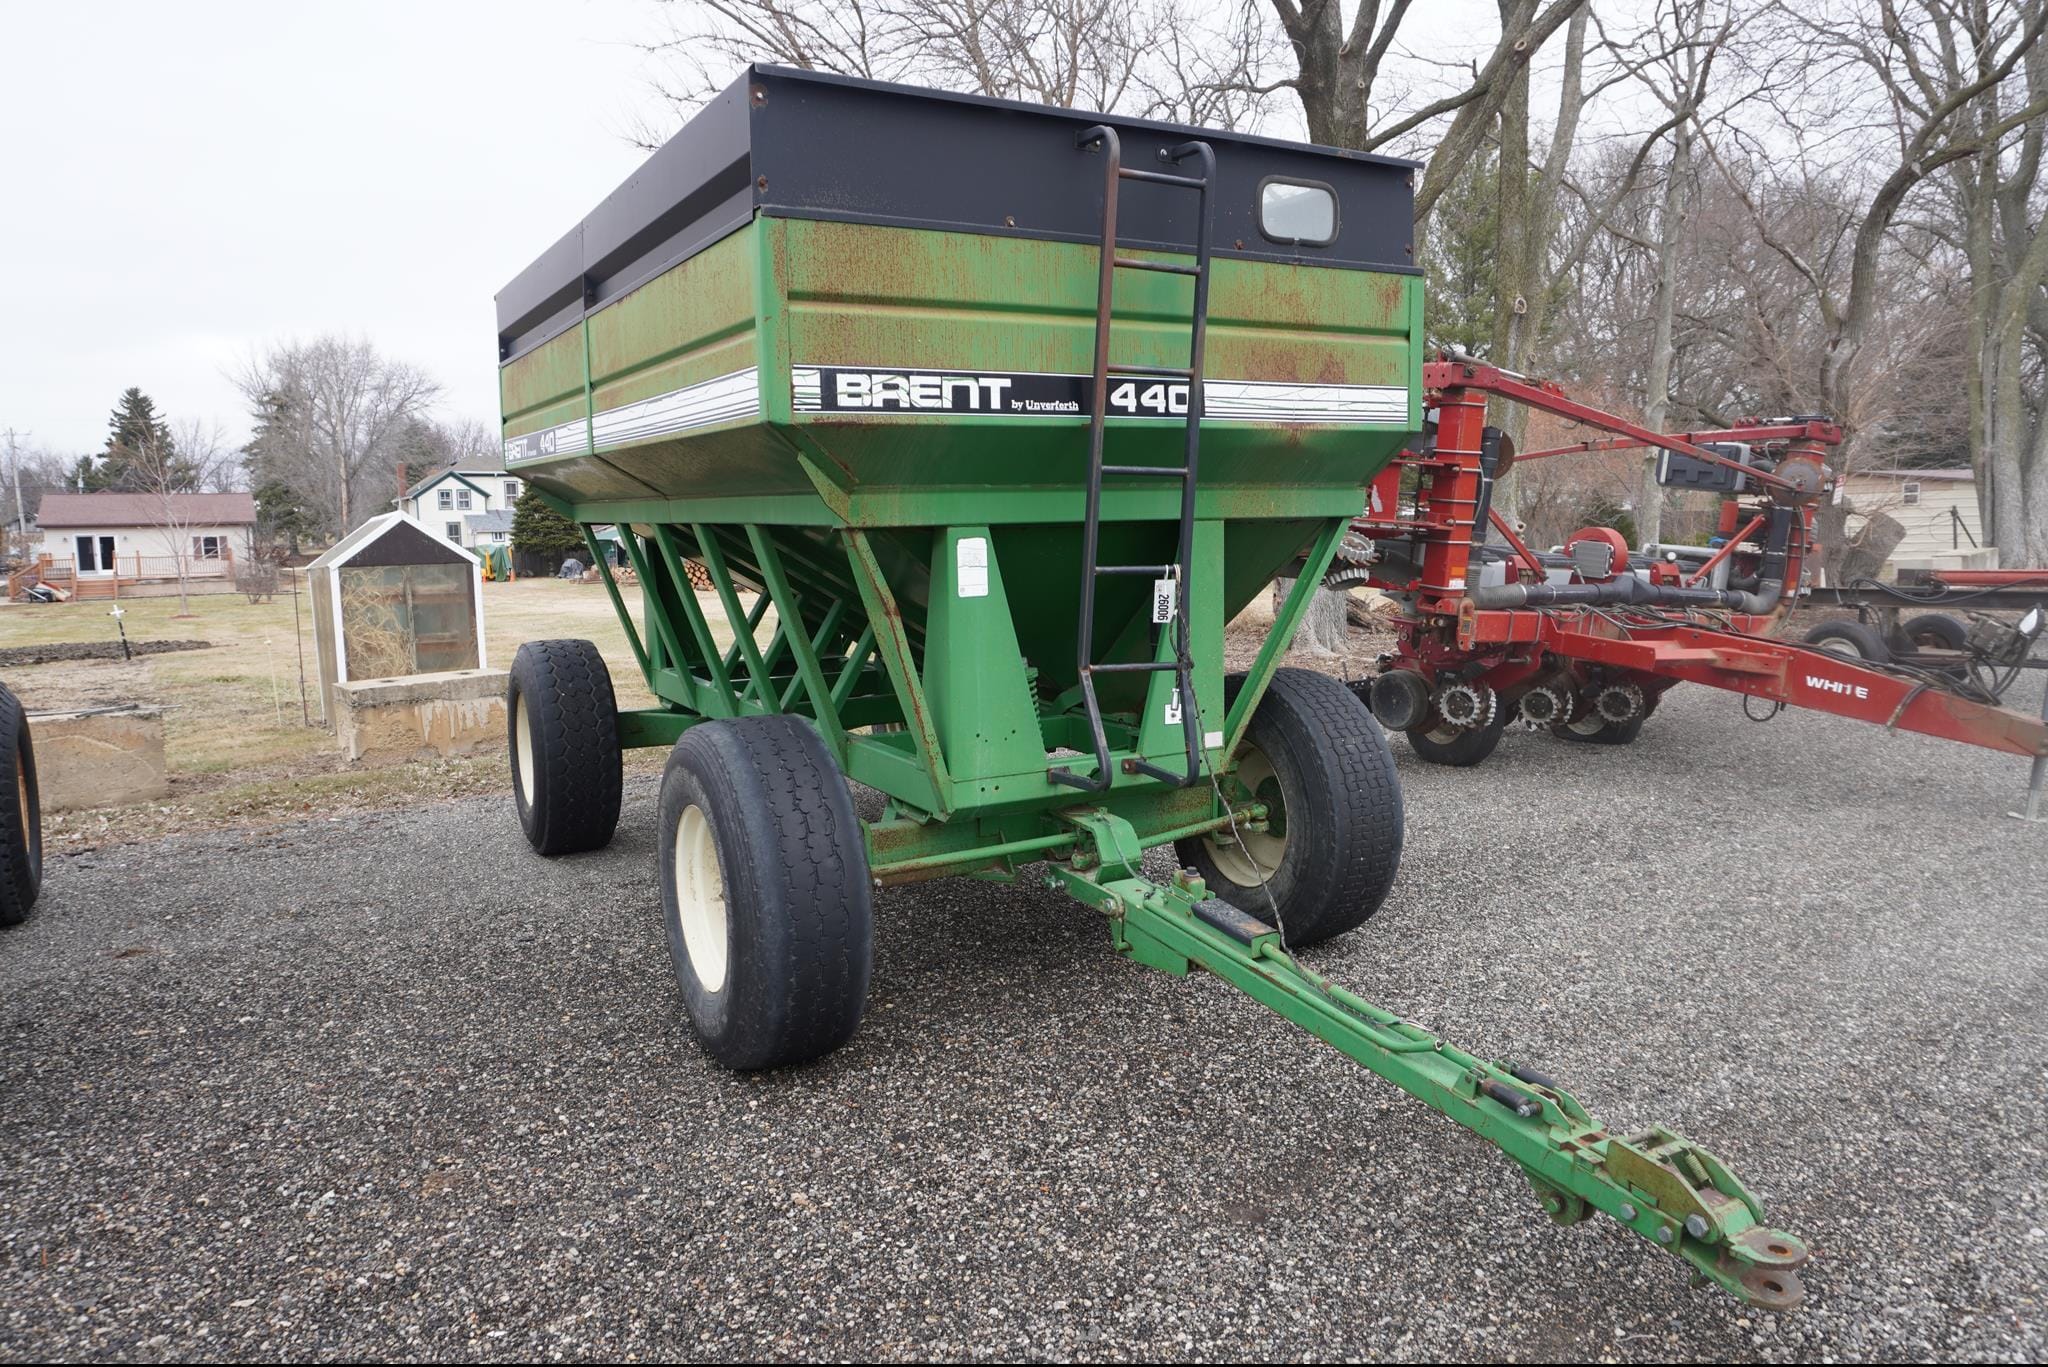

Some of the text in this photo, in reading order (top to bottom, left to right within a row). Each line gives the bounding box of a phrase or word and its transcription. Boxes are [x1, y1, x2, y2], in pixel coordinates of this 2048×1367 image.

[836, 373, 1190, 414] BRENT by Unverferth 440
[1157, 594, 1170, 621] 26006
[1805, 675, 1869, 700] WHITE
